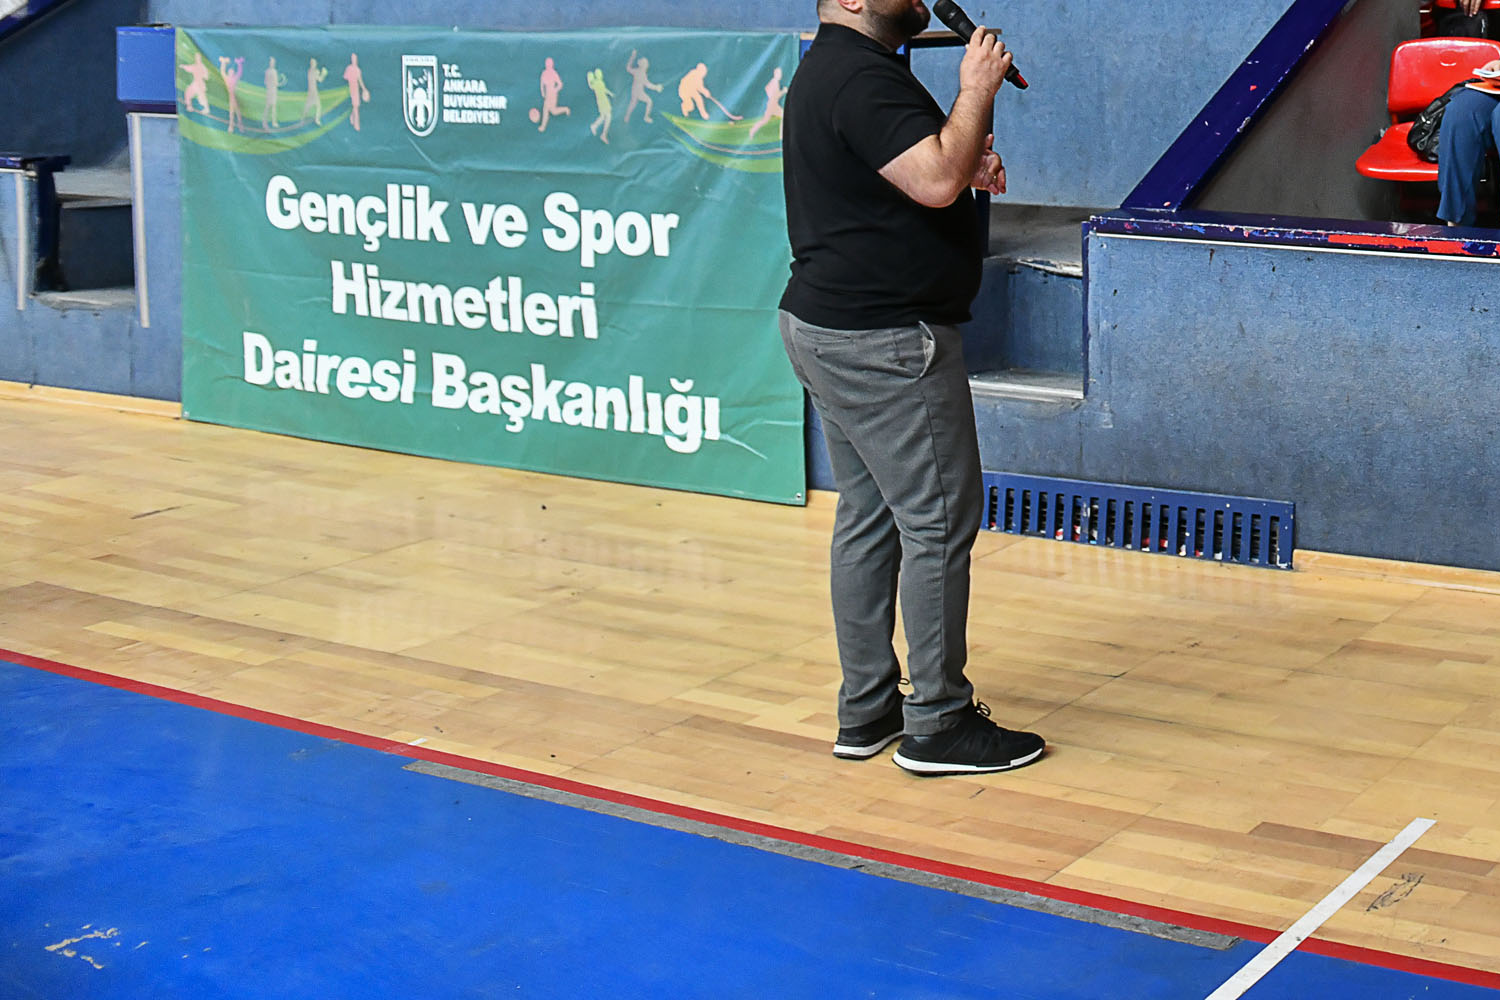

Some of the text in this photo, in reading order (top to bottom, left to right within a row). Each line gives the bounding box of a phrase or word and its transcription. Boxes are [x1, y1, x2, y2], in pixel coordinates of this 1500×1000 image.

[443, 79, 488, 93] ANKARA
[265, 175, 679, 267] Gençlik ve Spor
[330, 260, 599, 339] Hizmetleri
[243, 332, 721, 454] Dairesi Başkanlığı
